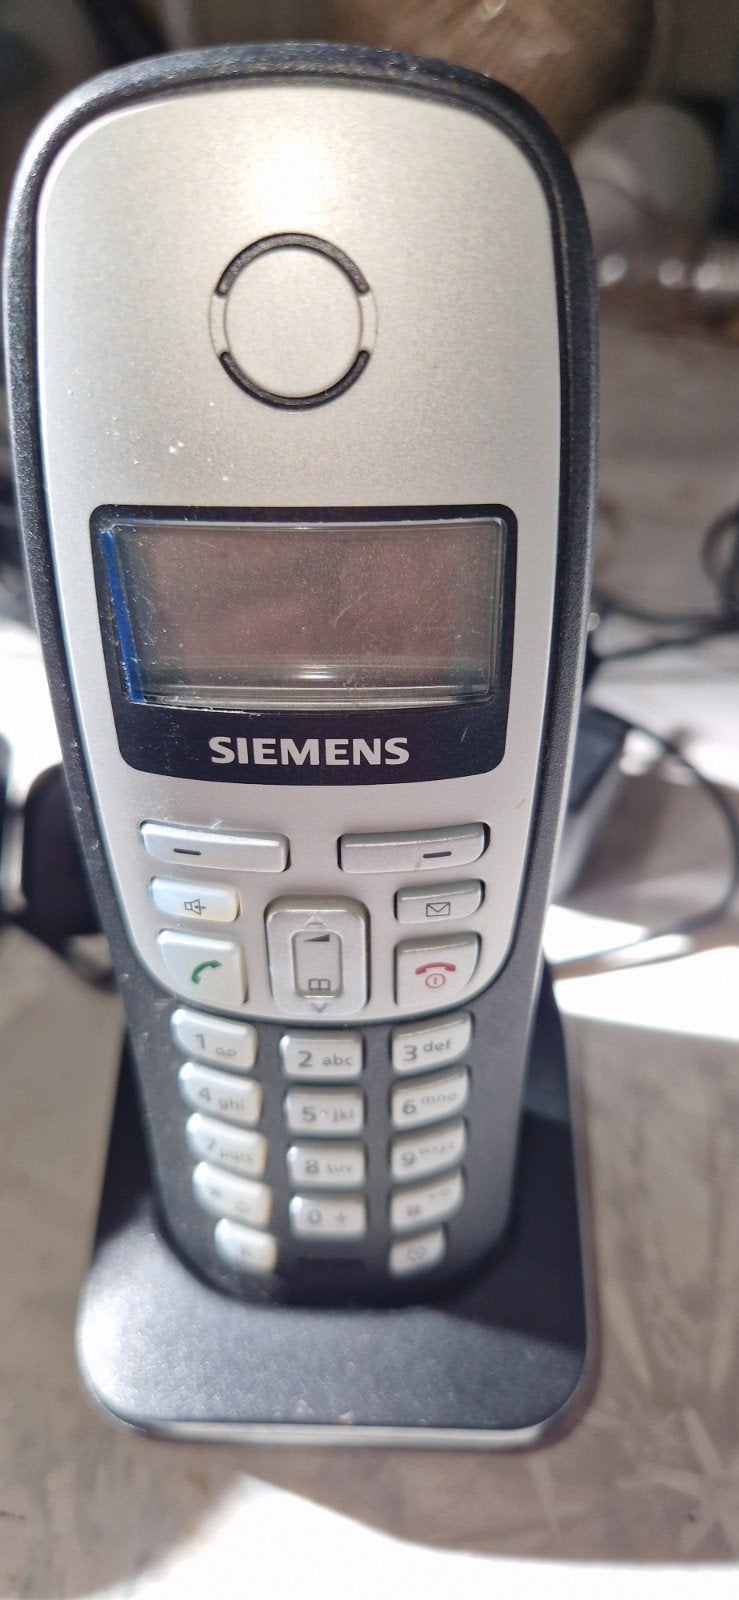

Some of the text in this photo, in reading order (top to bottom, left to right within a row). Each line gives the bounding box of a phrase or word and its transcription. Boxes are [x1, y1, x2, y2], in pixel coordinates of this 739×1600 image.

[208, 736, 411, 766] SIEMENS
[195, 1032, 207, 1050] 1
[298, 1050, 355, 1067] 2 abc
[403, 1038, 453, 1062] 3 def
[199, 1086, 211, 1101] 4
[301, 1106, 317, 1123] 5
[402, 1099, 417, 1115] 6
[304, 1159, 320, 1174] 8
[401, 1151, 416, 1167] 9
